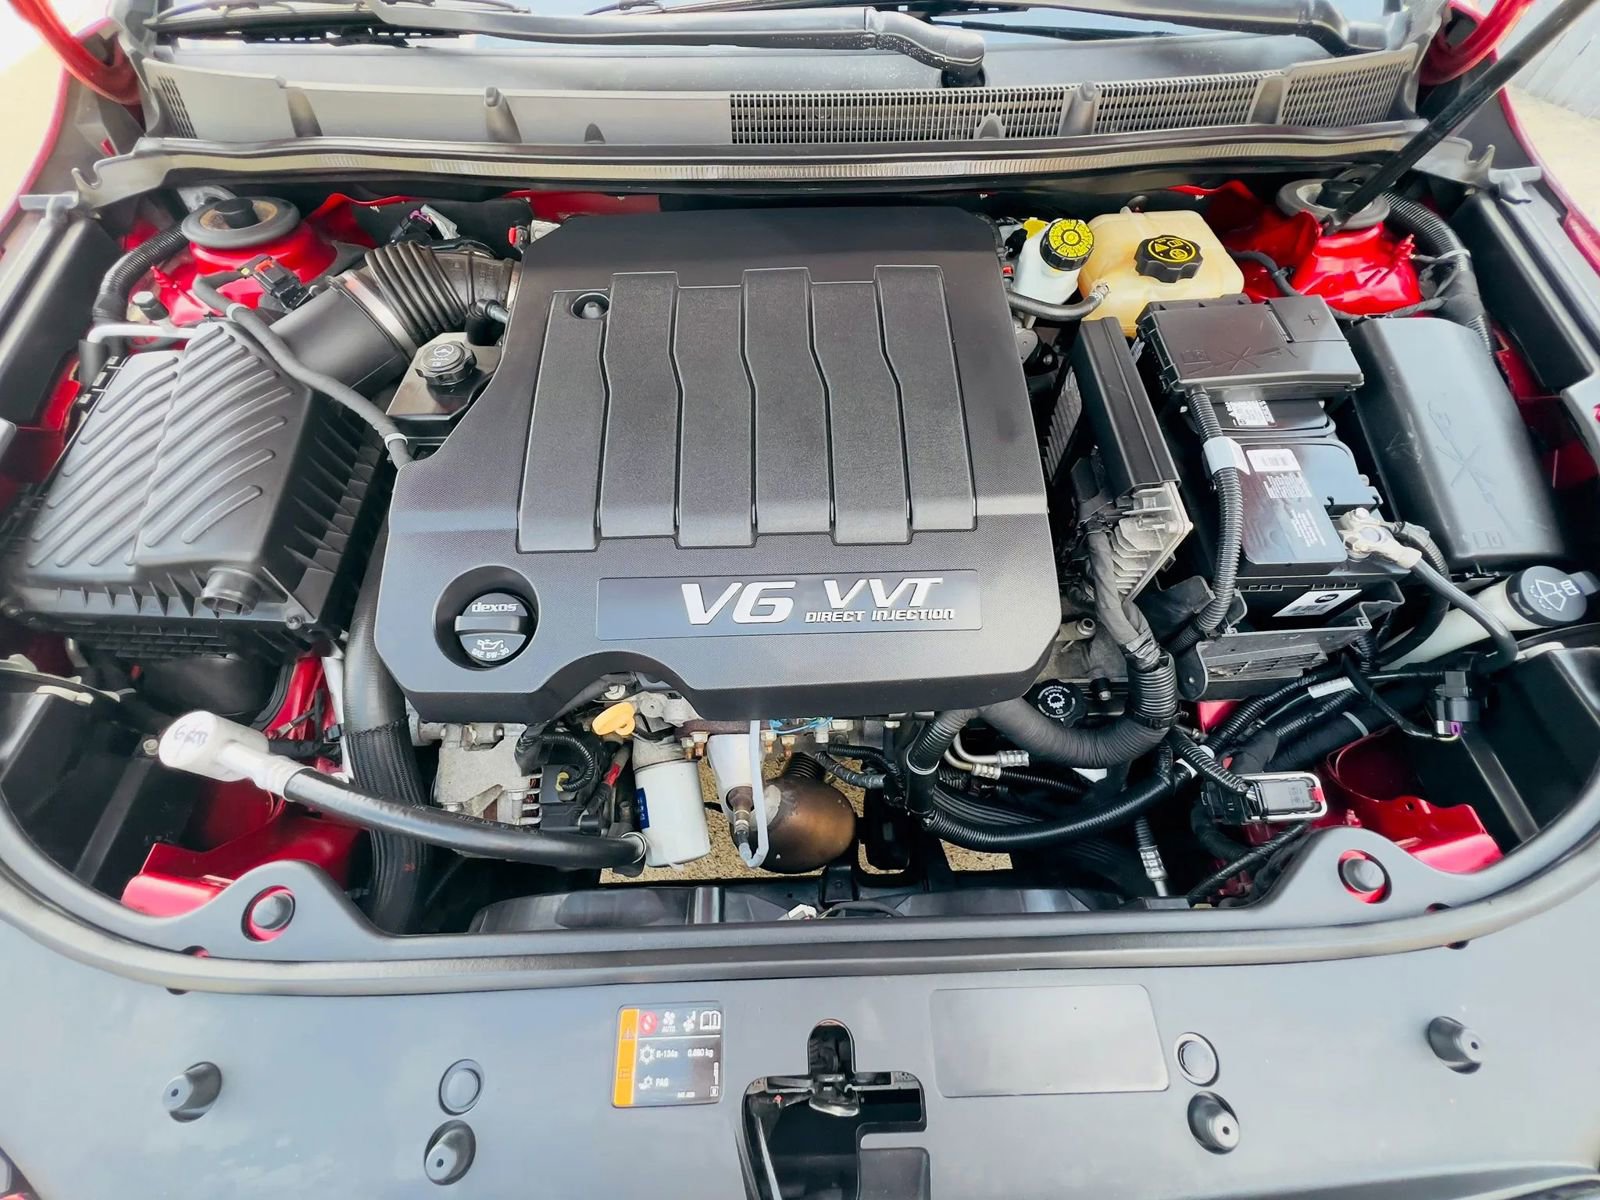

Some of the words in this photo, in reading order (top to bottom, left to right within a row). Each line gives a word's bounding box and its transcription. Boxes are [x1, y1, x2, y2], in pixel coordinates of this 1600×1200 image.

[471, 602, 519, 612] dexos
[681, 581, 797, 625] V6
[823, 577, 944, 608] VVT
[804, 610, 866, 623] DIRECT
[871, 608, 956, 622] INJECTION
